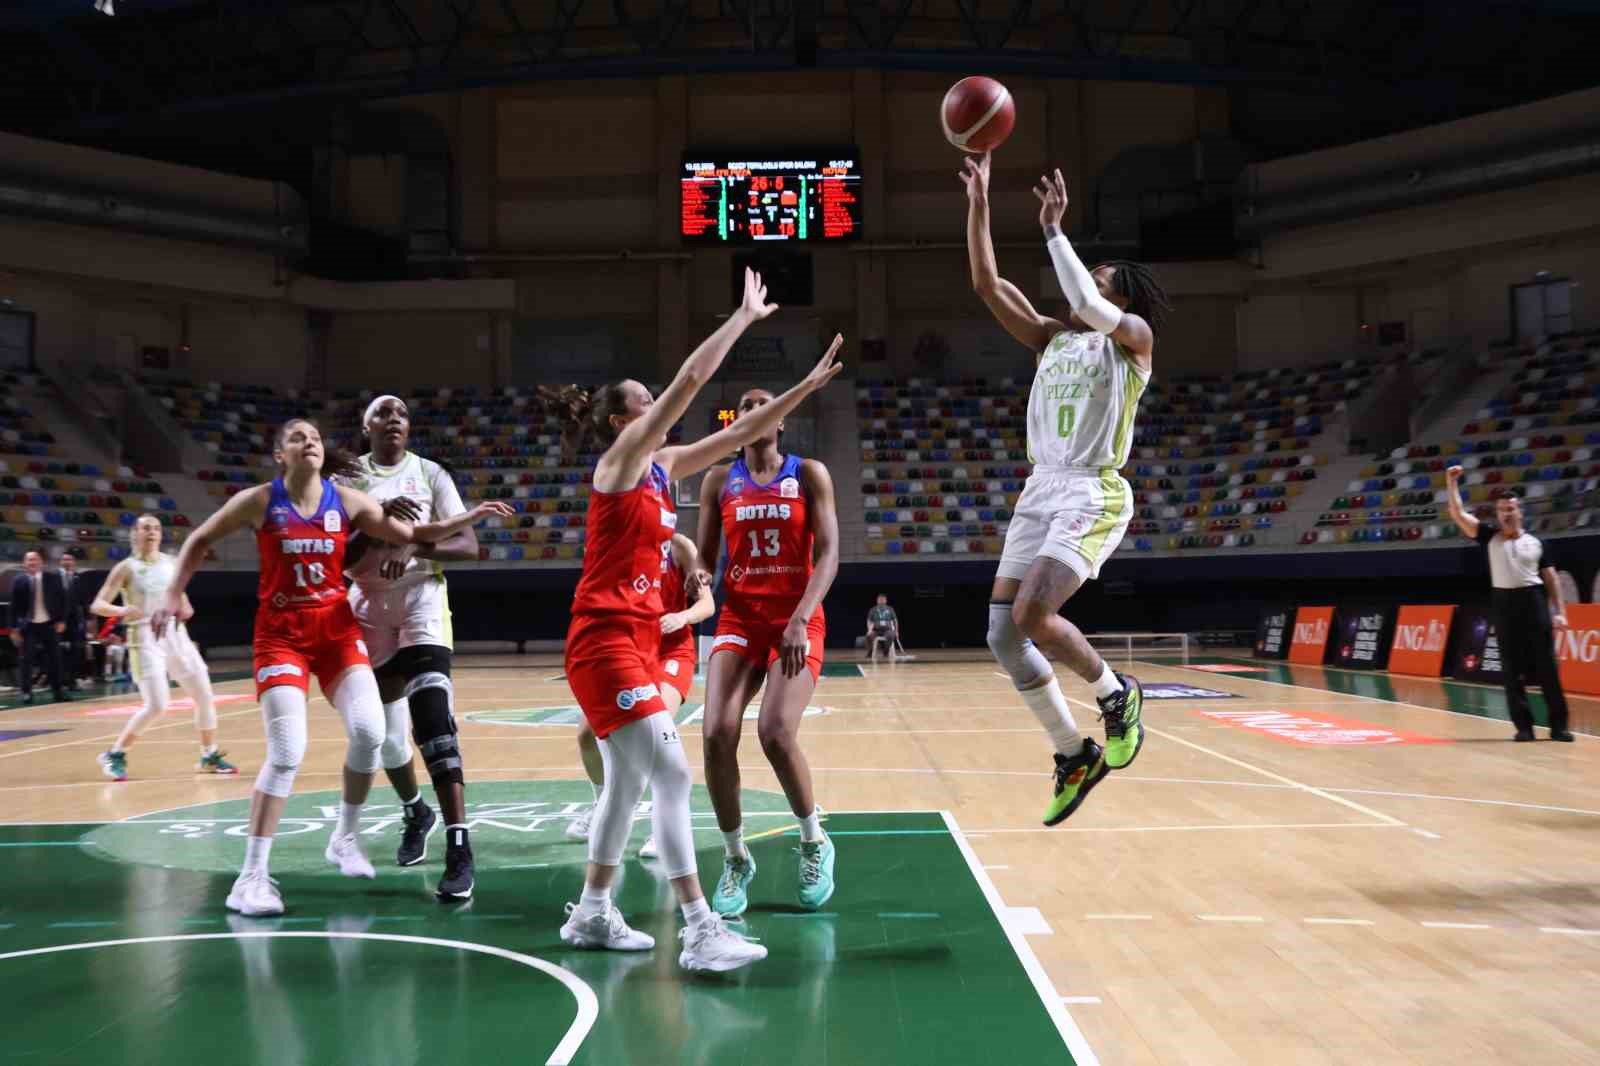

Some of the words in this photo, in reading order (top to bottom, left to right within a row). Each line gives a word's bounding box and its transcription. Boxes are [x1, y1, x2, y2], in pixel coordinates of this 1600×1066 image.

[1046, 383, 1097, 400] PIZZA
[1058, 405, 1075, 437] 0
[747, 528, 780, 557] 13
[1393, 624, 1425, 651] ING
[1554, 630, 1600, 663] ING
